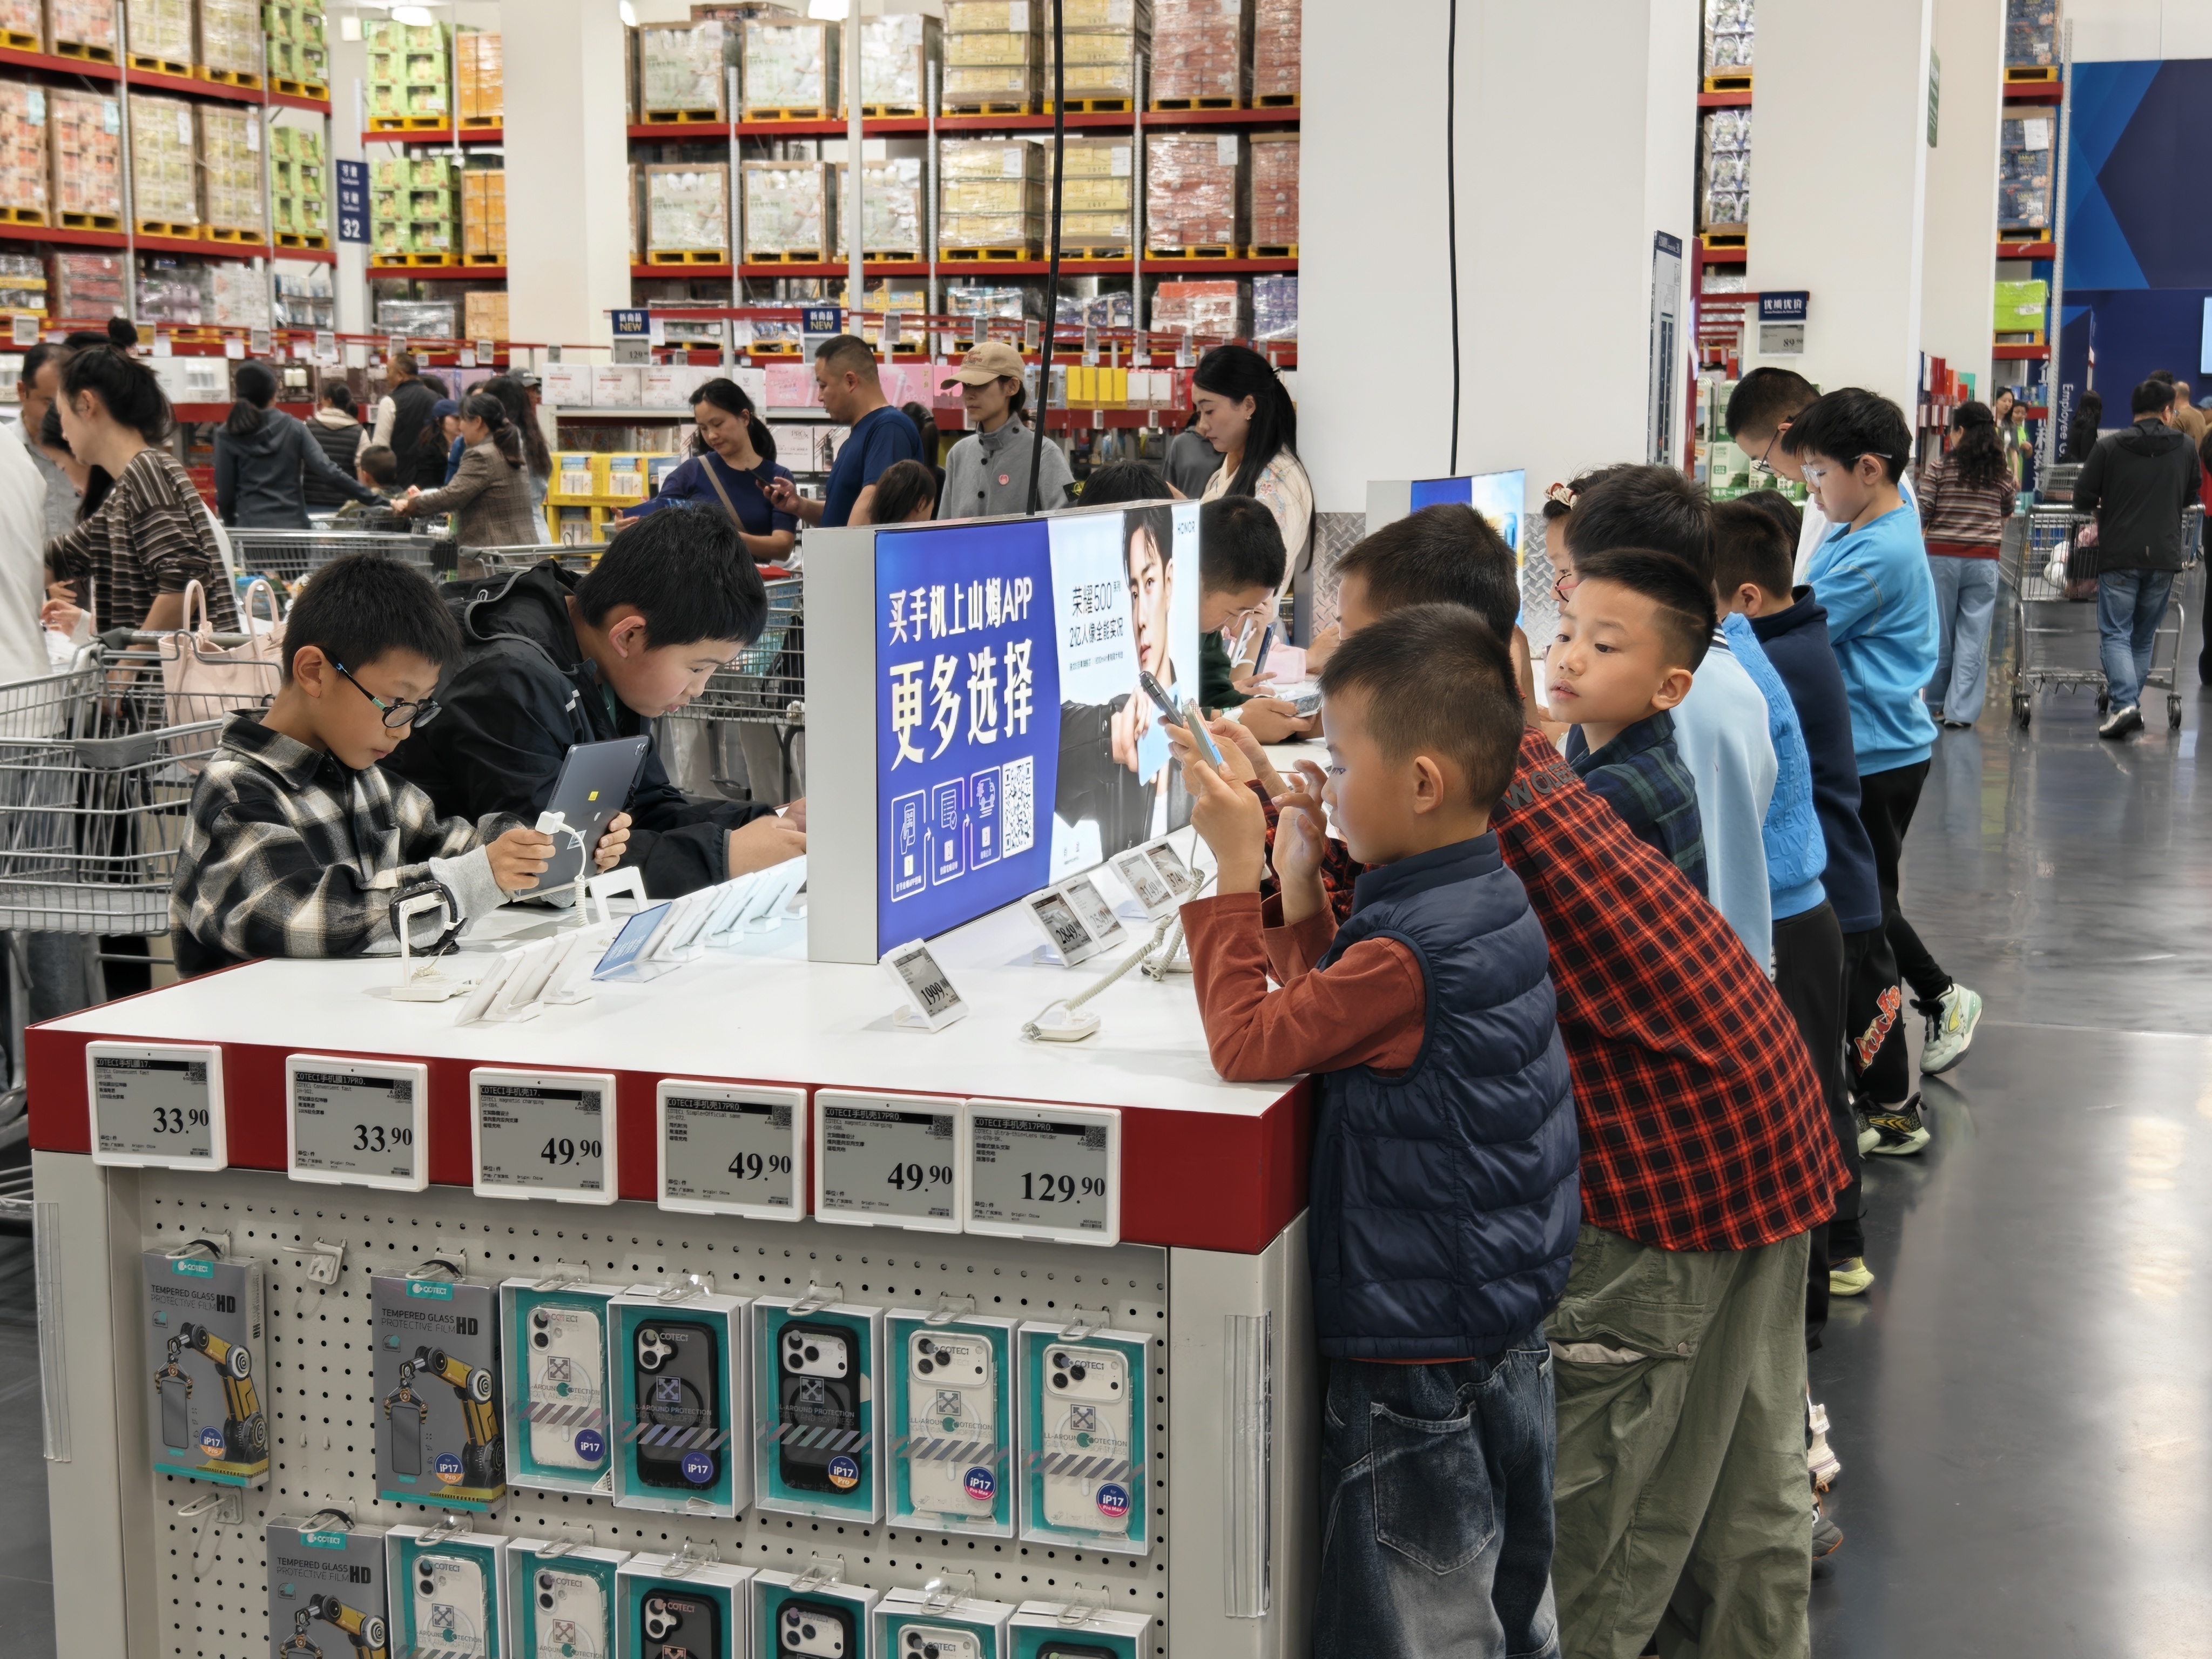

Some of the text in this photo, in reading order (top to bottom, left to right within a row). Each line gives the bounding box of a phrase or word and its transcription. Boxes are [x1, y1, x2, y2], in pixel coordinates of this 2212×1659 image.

[342, 218, 361, 238] 32
[619, 322, 642, 332] NEW
[811, 321, 833, 331] NEW
[2059, 383, 2073, 440] Employee
[1177, 521, 1195, 535] HONOR
[889, 577, 1033, 646] 买手机上山姆APP
[889, 638, 1033, 771] 更多选择
[96, 1058, 151, 1068] COTECI手机17.
[153, 1107, 209, 1134] 33.90
[354, 1124, 412, 1152] 33.90
[541, 1138, 602, 1165] 49.90
[729, 1152, 791, 1181] 49.90
[888, 1163, 953, 1192] 49.90
[1021, 1172, 1105, 1204] 129.90
[151, 1284, 215, 1301] TEMPERED GLASS
[151, 1294, 216, 1311] PROTECTIVE FILM
[217, 1294, 236, 1313] HD
[382, 1308, 454, 1324] TEMPERED GLASS
[381, 1318, 456, 1333] PROTECTIVE FILM
[456, 1316, 478, 1336] HD
[671, 1407, 712, 1416] PROTECTION
[814, 1408, 855, 1418] PROTECTION
[204, 1436, 220, 1447] iP17
[581, 1441, 600, 1452] iP17
[440, 1464, 458, 1473] iP17
[688, 1464, 708, 1474] iP17
[834, 1466, 854, 1477] iP17
[970, 1478, 990, 1491] iP17
[1103, 1494, 1124, 1507] iP17
[277, 1557, 348, 1572] TEMPERED GLASS
[276, 1567, 349, 1582] PROTECTIVE FILM
[350, 1565, 372, 1584] HD
